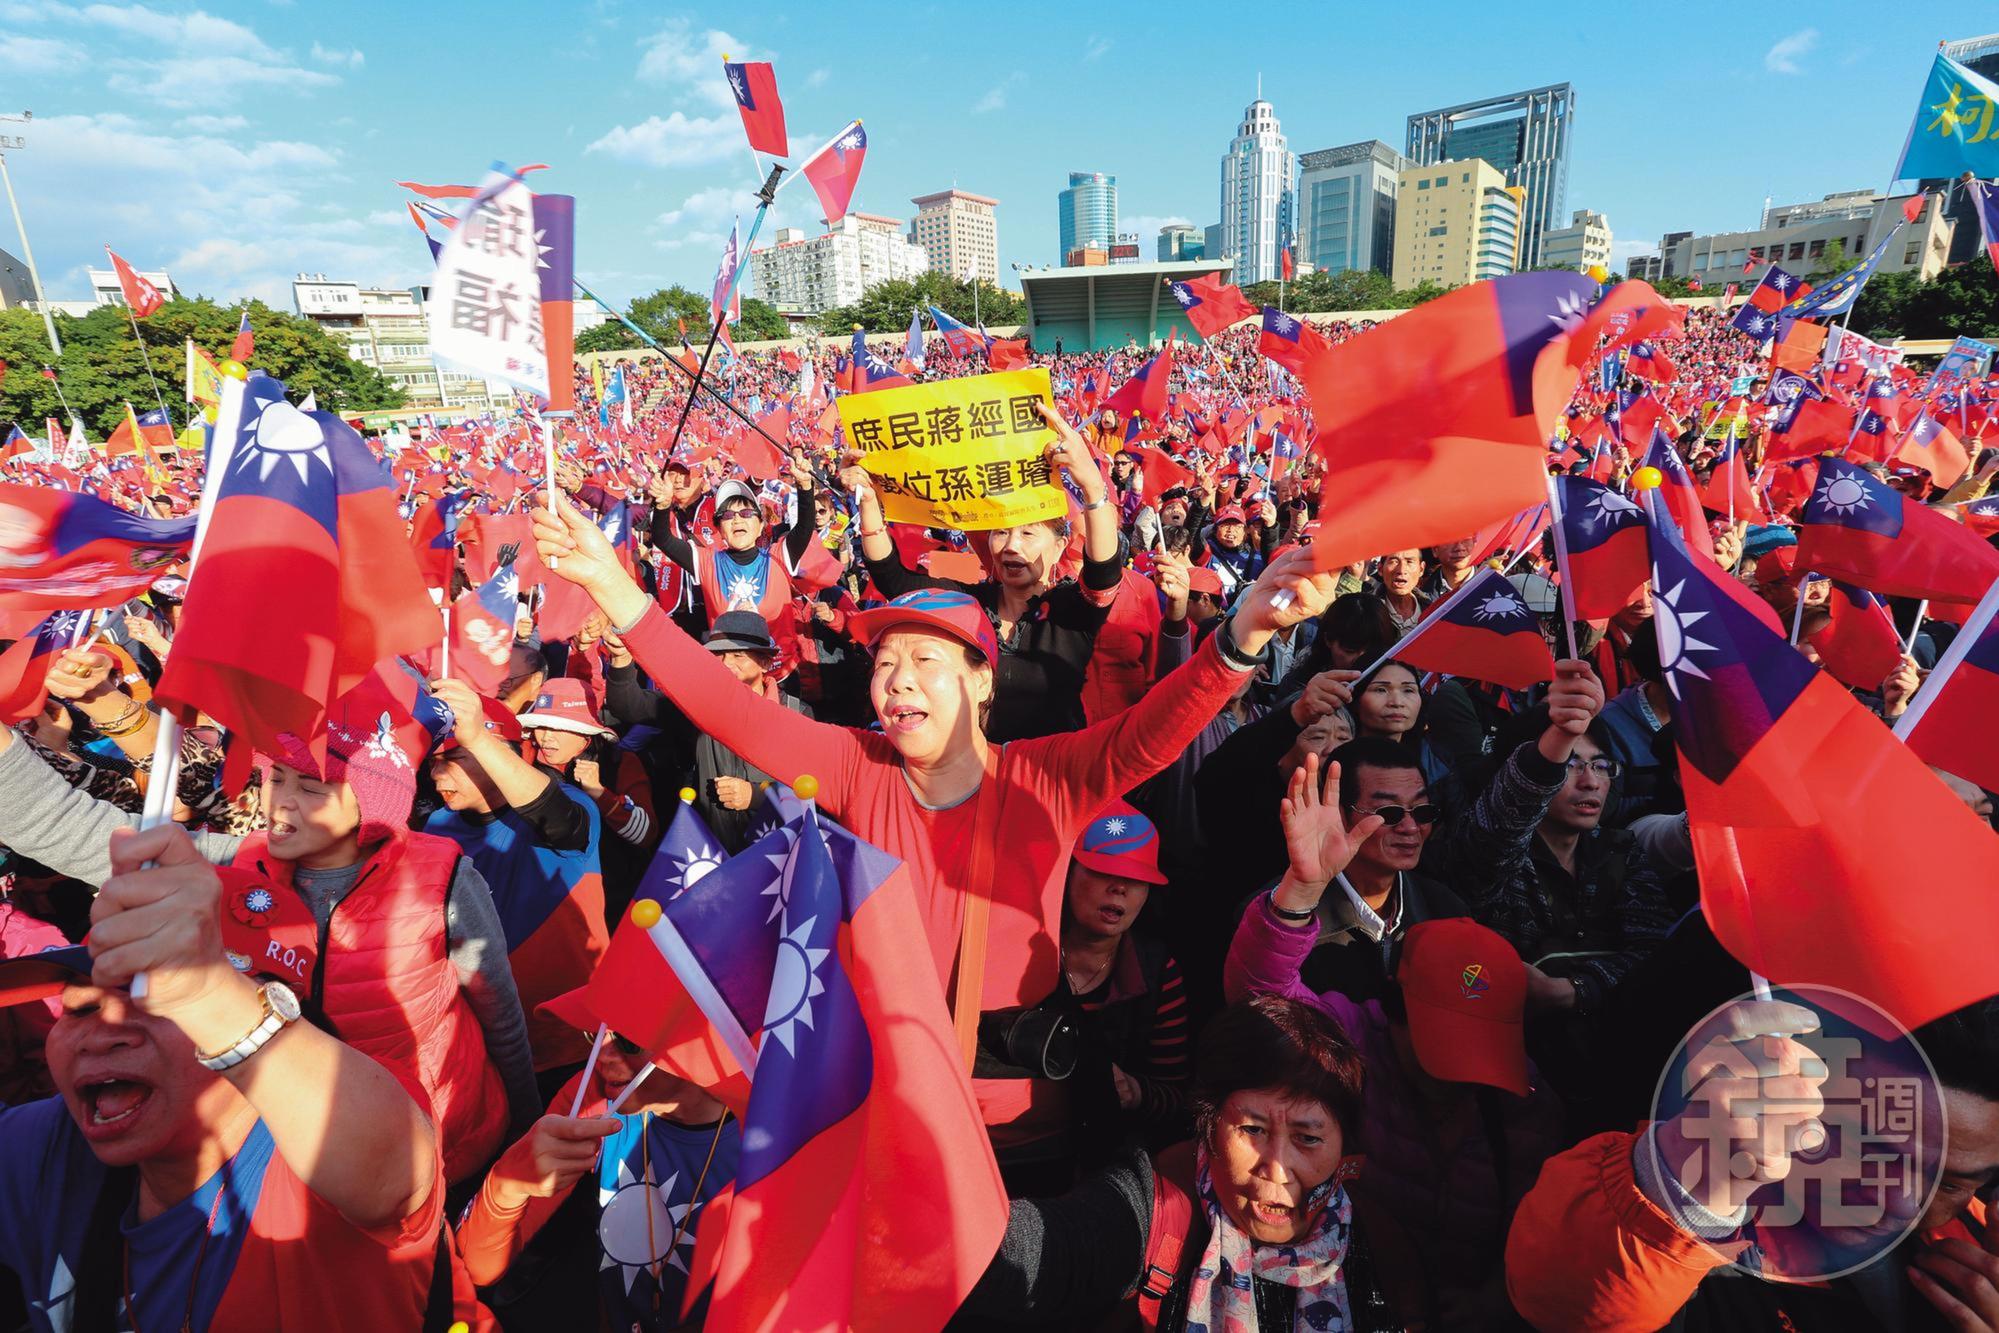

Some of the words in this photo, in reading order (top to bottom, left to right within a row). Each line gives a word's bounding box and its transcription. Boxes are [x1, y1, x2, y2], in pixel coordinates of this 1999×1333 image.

[1927, 83, 1999, 143] 柯
[851, 394, 1049, 452] 庶民蔣經國
